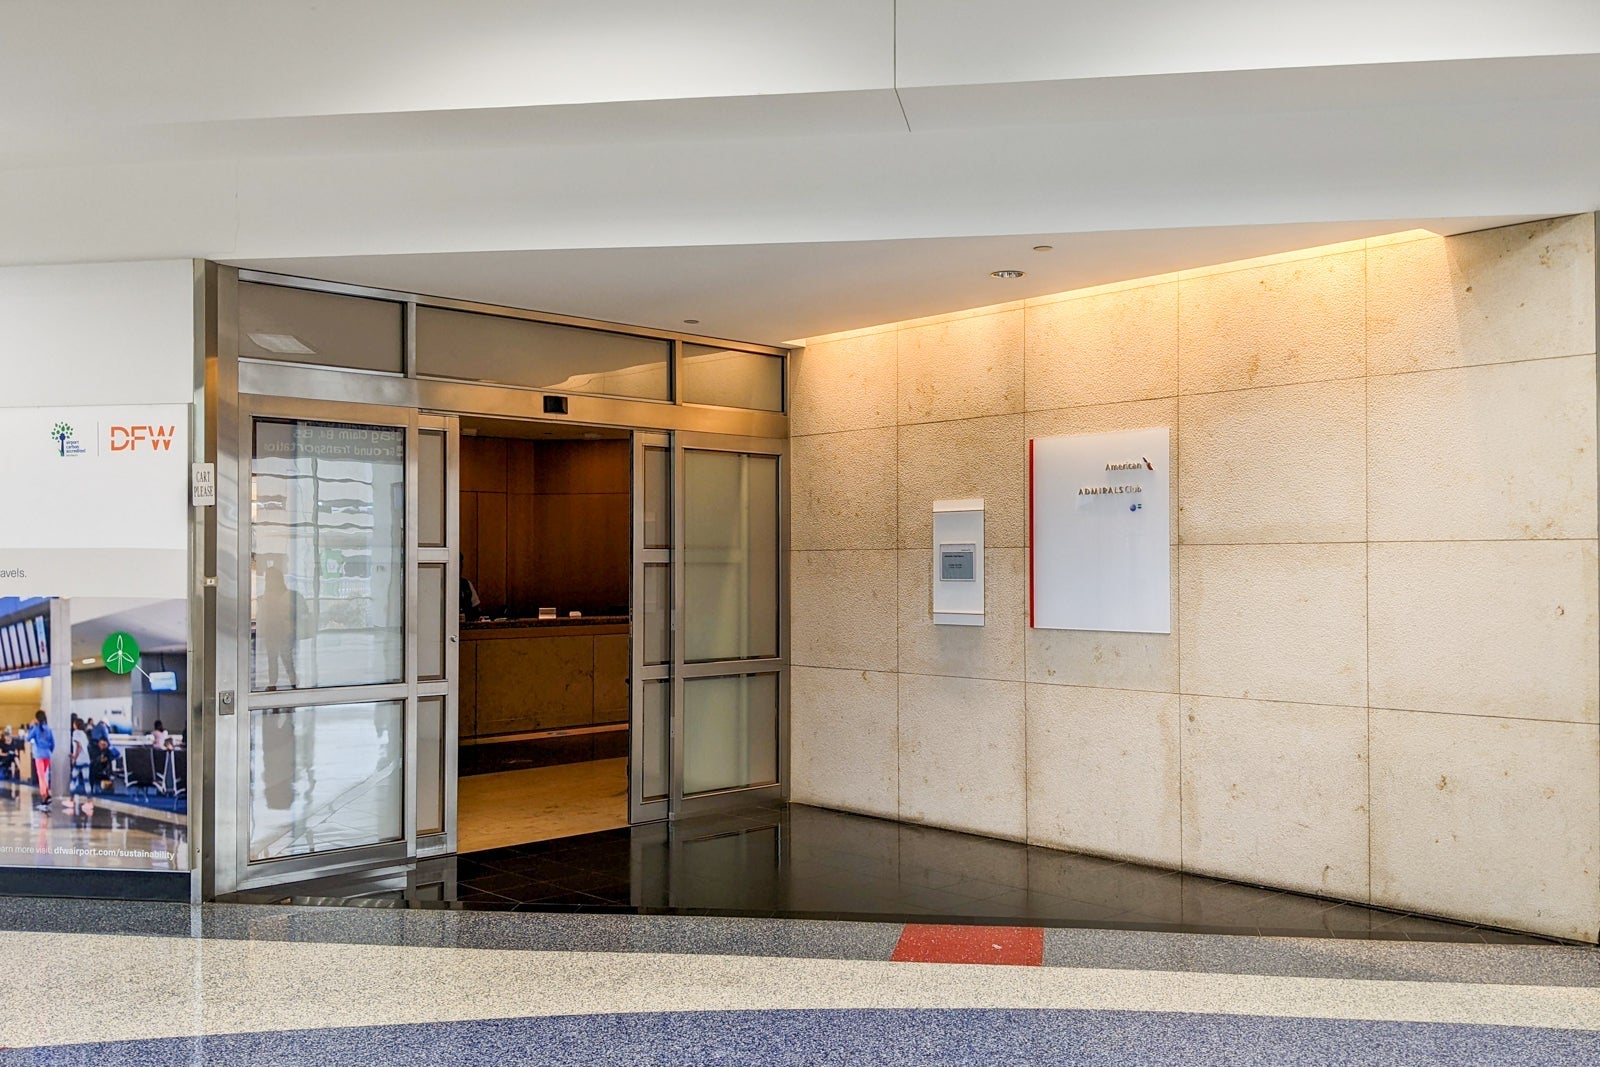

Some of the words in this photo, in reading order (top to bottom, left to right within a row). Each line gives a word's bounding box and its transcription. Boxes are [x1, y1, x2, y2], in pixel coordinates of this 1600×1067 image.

[110, 425, 175, 451] DFW
[1105, 462, 1142, 471] American
[196, 471, 210, 482] CART
[194, 486, 213, 497] PLEASE
[1078, 486, 1123, 495] ADMIRALS
[1124, 485, 1142, 493] Club
[54, 847, 175, 861] dfwairport.com/sustainability
